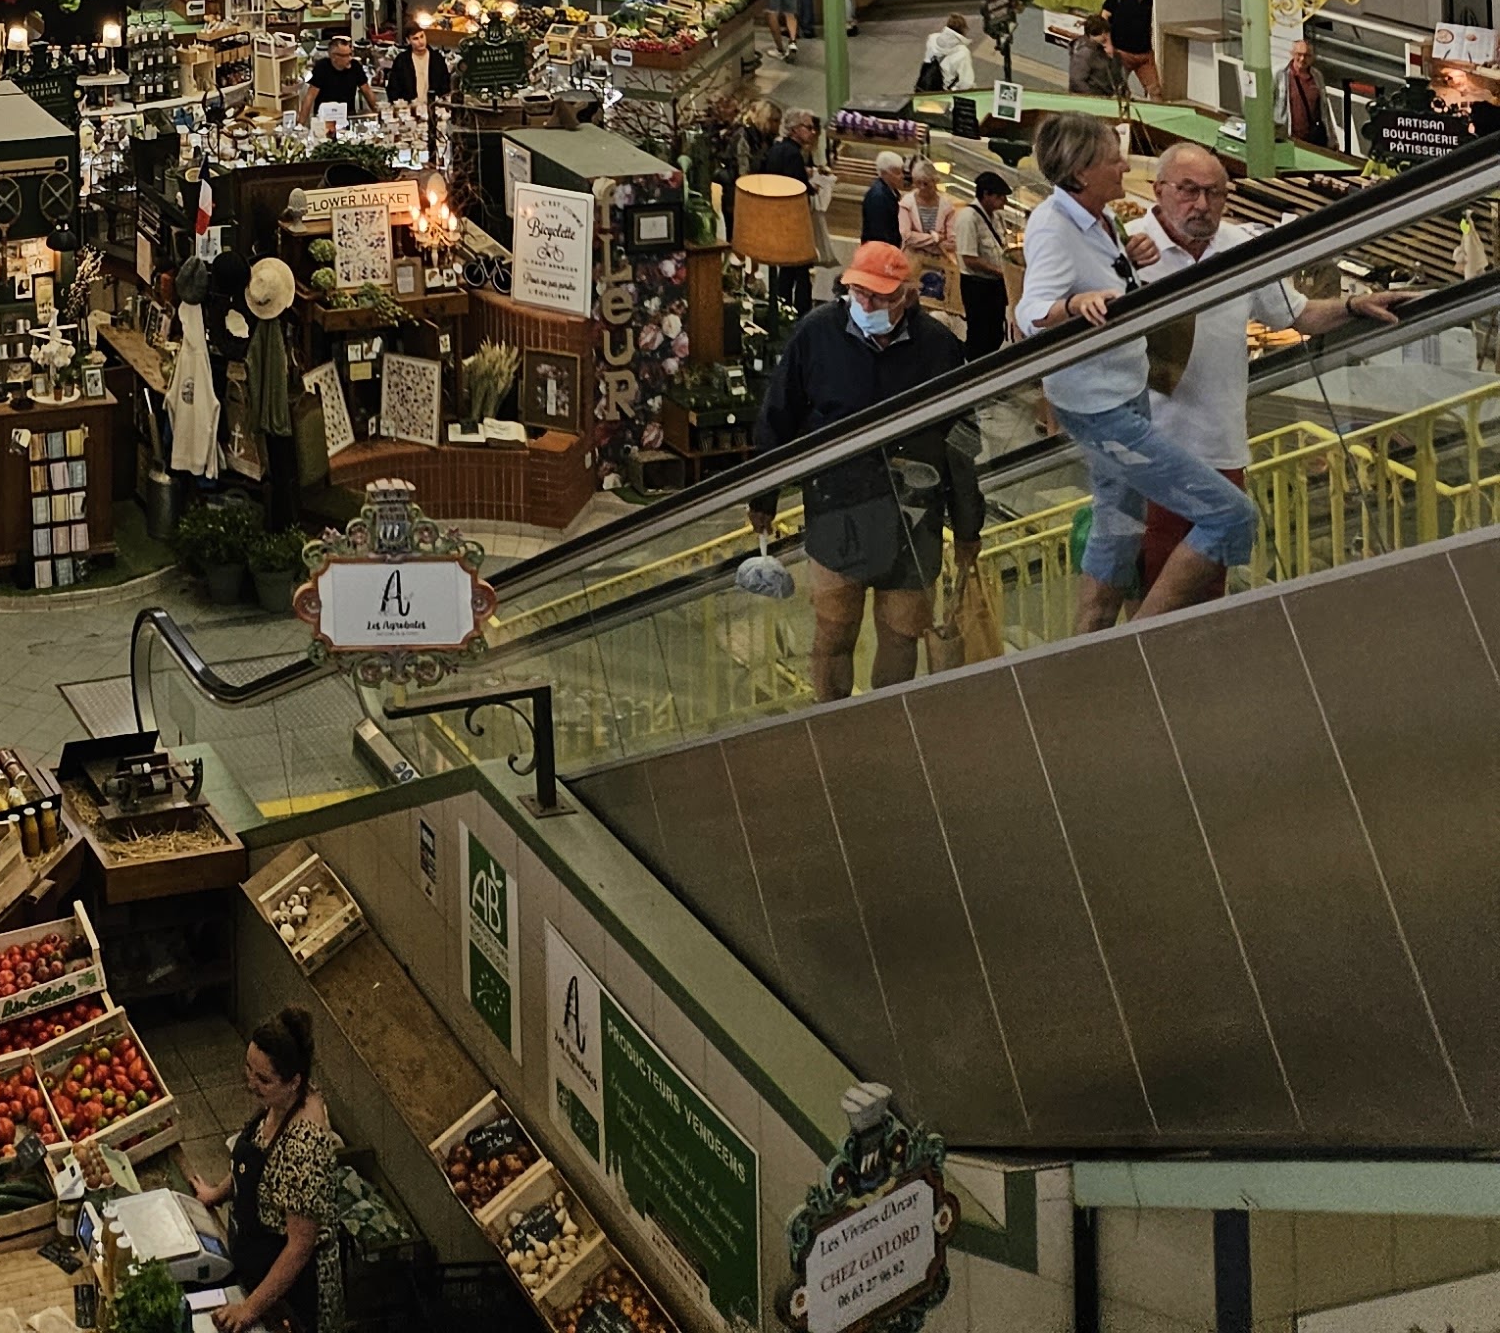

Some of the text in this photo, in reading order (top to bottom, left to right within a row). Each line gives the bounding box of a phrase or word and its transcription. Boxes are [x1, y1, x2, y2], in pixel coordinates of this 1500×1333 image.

[1397, 117, 1444, 131] ARTISAN
[1382, 128, 1459, 145] BOULANGERIE
[307, 195, 356, 211] FLOWER
[527, 217, 575, 241] Bicyclette
[367, 621, 381, 630] Les
[472, 869, 501, 934] AB
[607, 1018, 681, 1114] PRODUCTEURS
[684, 1104, 746, 1184] VENDÉENS
[820, 1237, 840, 1257] Les
[820, 1225, 920, 1292] CHEZ GAYLORD
